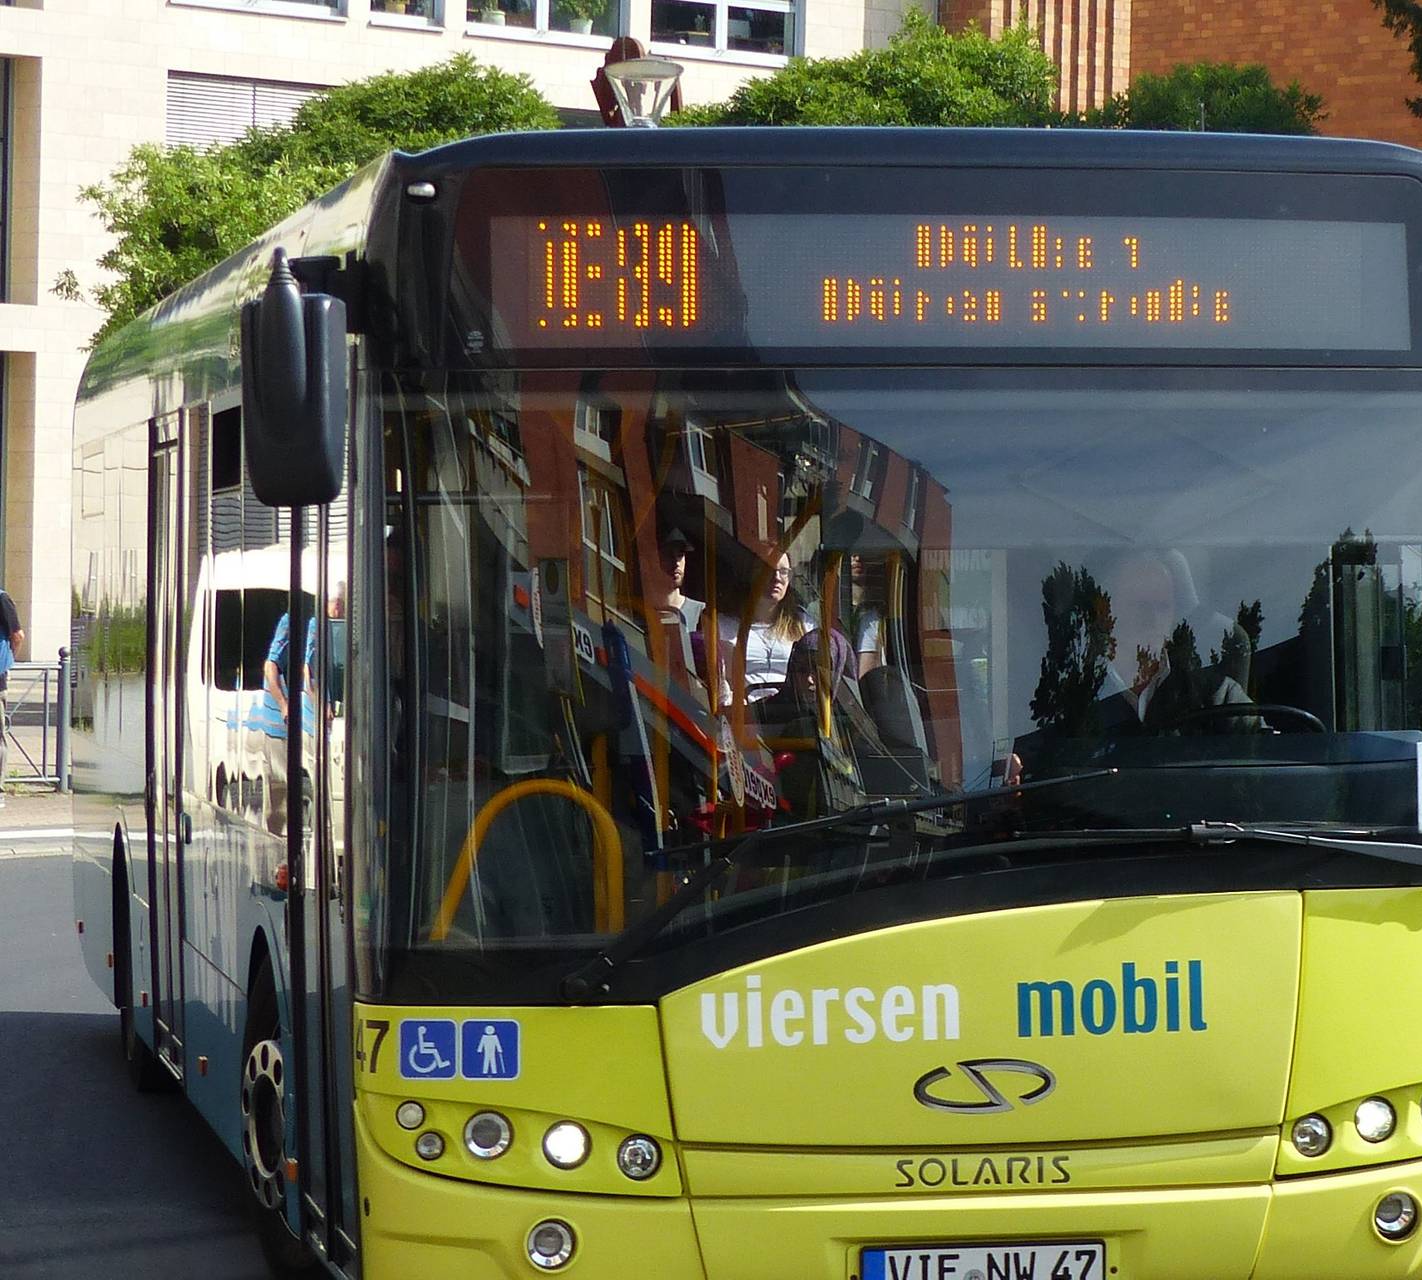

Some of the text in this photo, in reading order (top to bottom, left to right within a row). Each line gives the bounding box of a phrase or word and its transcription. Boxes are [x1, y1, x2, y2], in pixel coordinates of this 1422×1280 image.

[699, 959, 1207, 1049] viersen mobil
[356, 1019, 390, 1073] 47
[895, 1155, 1070, 1187] SOLARIS
[987, 1251, 1036, 1280] NW
[1051, 1250, 1097, 1280] 47
